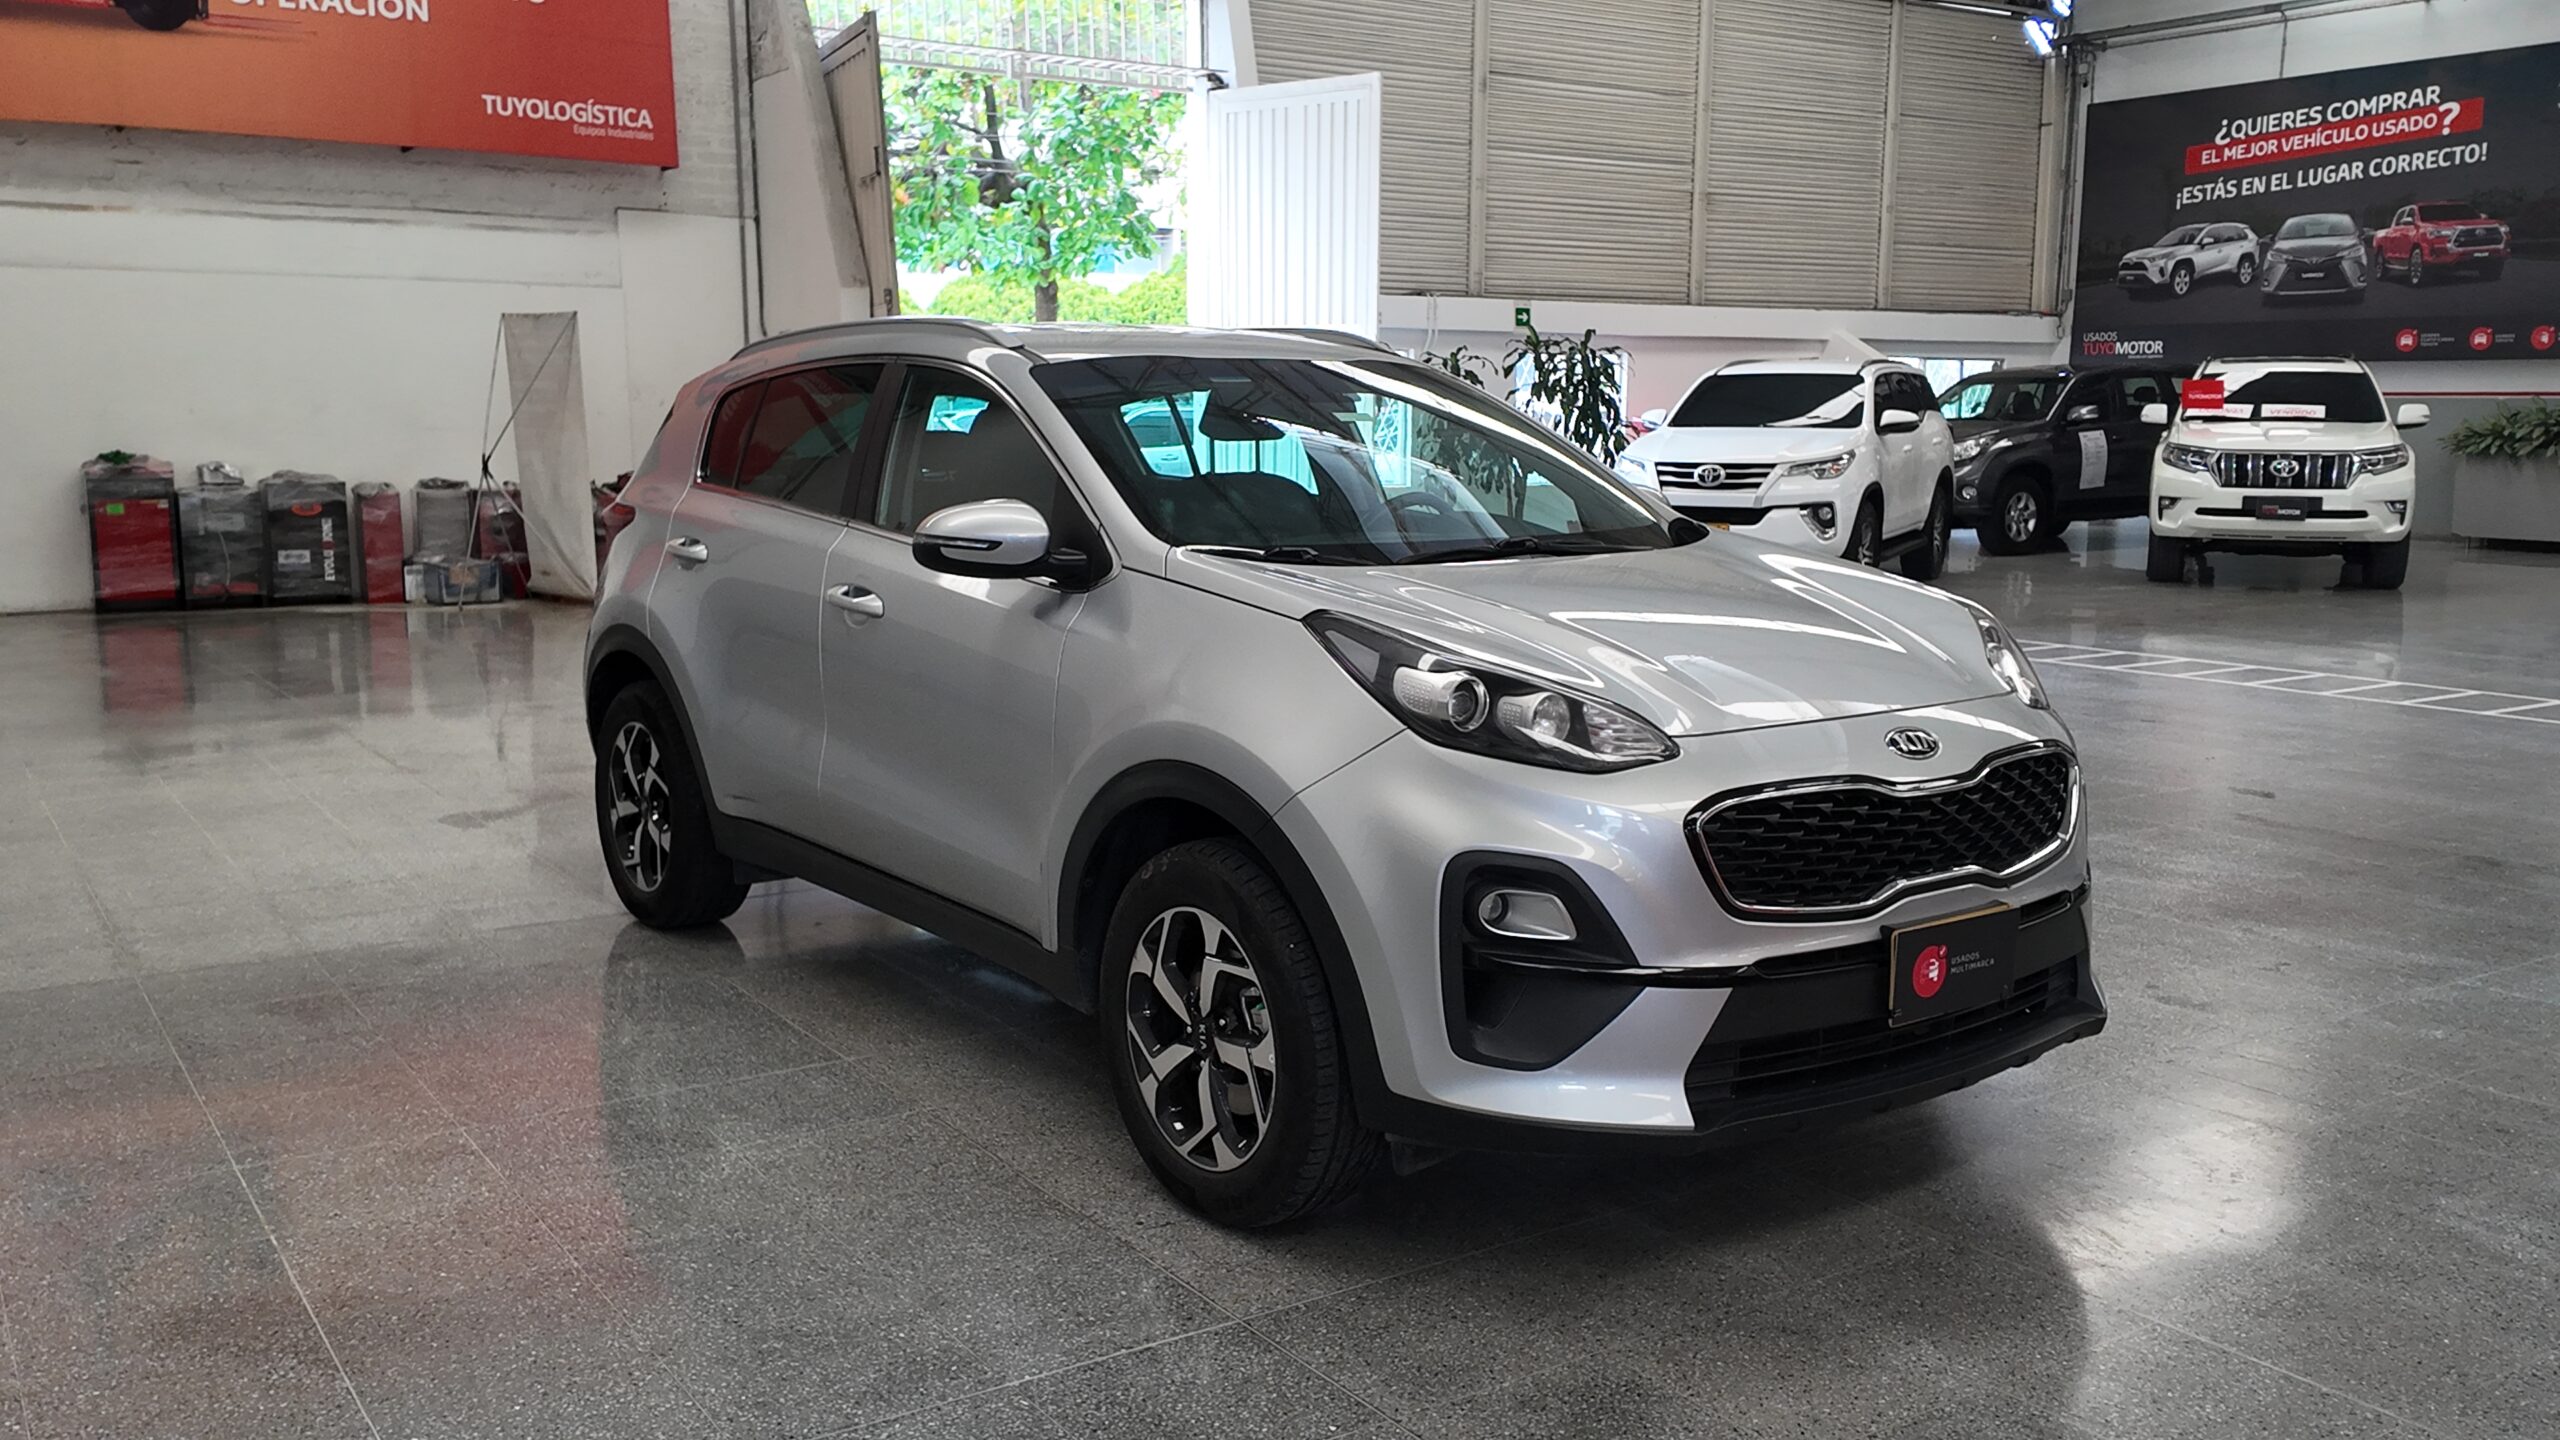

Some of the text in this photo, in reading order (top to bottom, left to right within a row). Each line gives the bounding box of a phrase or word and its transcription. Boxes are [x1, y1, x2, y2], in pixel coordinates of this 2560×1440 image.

[481, 94, 653, 129] TUYOLOGÍSTICA
[2214, 85, 2441, 145] ¿QUIERES COMPRAR
[2201, 148, 2221, 165] EL
[2223, 141, 2278, 162] MEJOR
[2281, 124, 2369, 152] VEHÍCULO
[2176, 142, 2487, 210] ¡ESTÁS EN EL LUGAR CORRECTO!
[2083, 331, 2118, 342] USADOS
[2083, 340, 2163, 356] TUYOMOTOR
[1951, 952, 1980, 964] USADOS
[1951, 958, 1995, 974] MULTIMARCA
